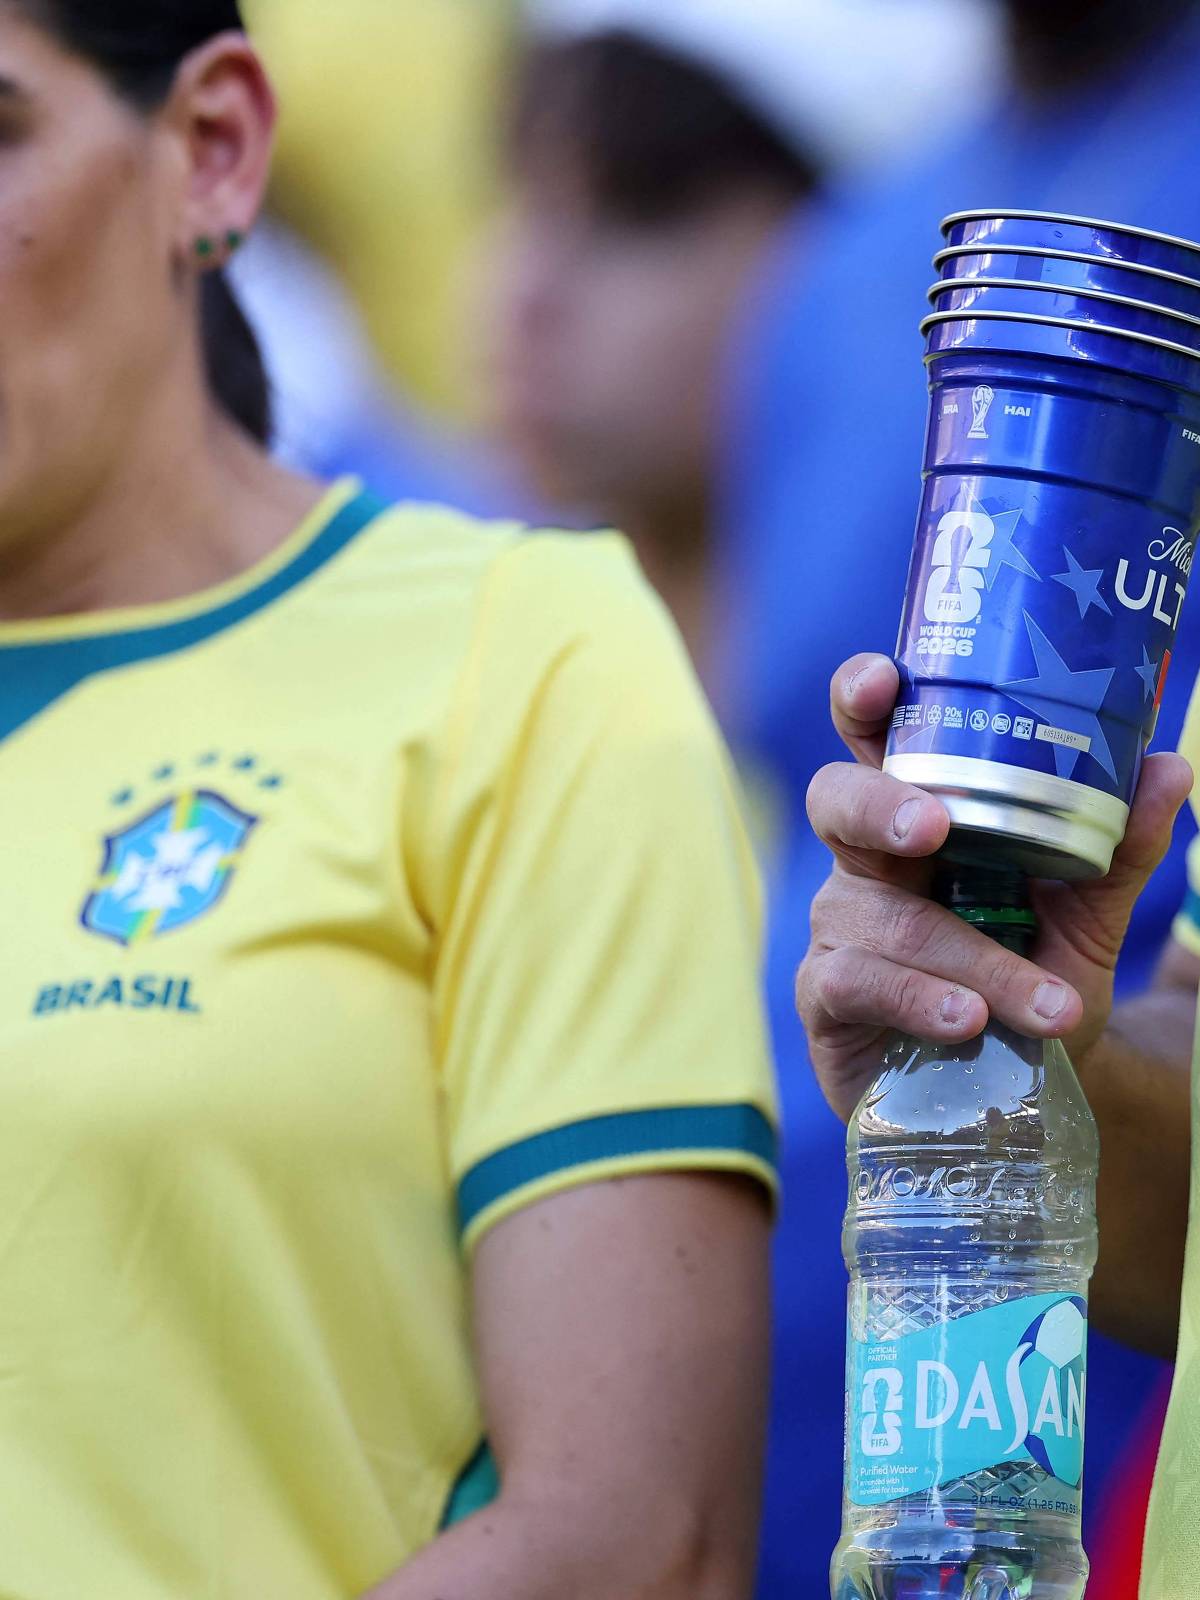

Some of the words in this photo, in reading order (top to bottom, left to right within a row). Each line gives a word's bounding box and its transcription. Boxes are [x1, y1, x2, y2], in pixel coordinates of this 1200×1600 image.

[943, 404, 959, 415] BRA
[1004, 404, 1031, 417] HAI
[1182, 428, 1200, 445] FIFA
[937, 599, 962, 612] FIFA
[919, 625, 952, 637] WORLD
[952, 626, 977, 638] CUP
[916, 637, 974, 657] 2026
[944, 706, 962, 718] 90%
[32, 974, 203, 1017] BRASIL
[868, 1346, 897, 1354] OFFICIAL
[867, 1353, 897, 1361] PARTNER
[914, 1341, 1086, 1455] DASAN
[871, 1438, 888, 1448] FIFA
[860, 1465, 888, 1477] Purified
[890, 1465, 919, 1474] Water
[991, 1495, 1006, 1506] FL
[1009, 1496, 1025, 1507] OZ
